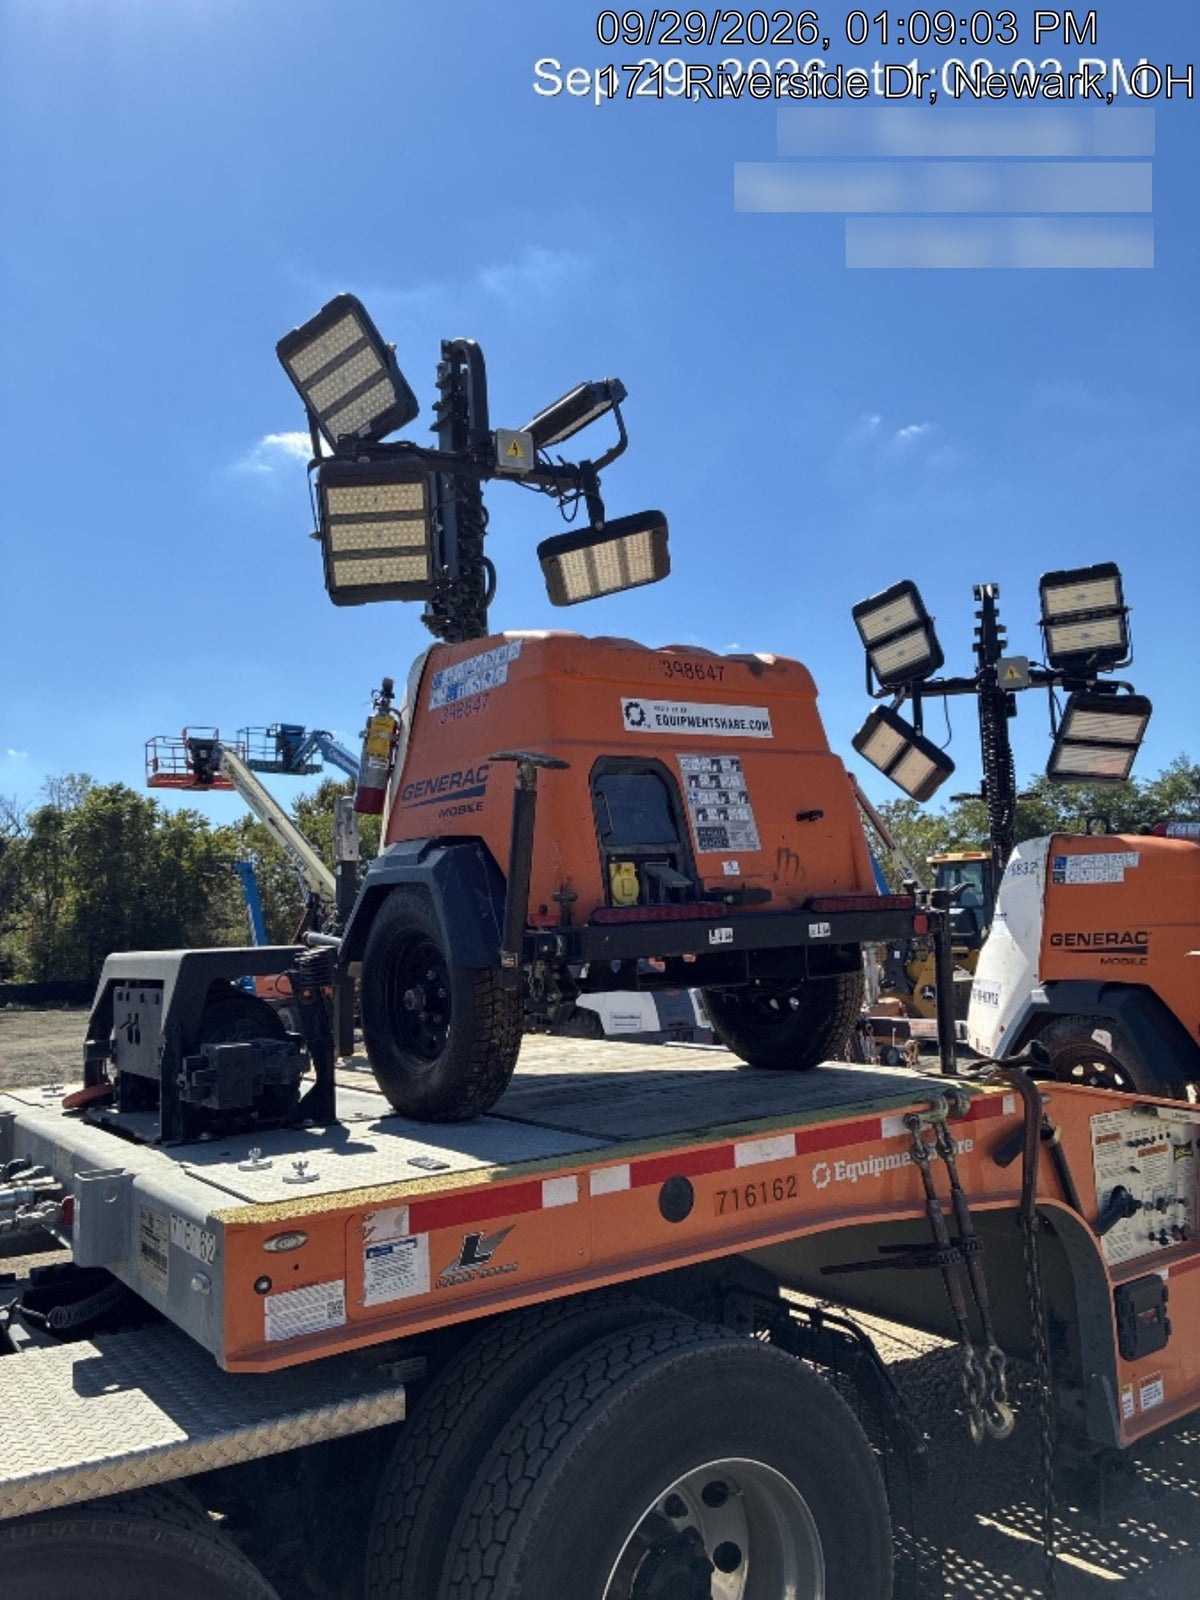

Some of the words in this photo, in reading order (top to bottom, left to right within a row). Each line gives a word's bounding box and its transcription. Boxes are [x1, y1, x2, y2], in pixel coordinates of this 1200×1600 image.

[661, 660, 725, 682] 398647
[402, 763, 490, 801] GENERAC
[438, 801, 485, 819] MOBILE
[1050, 932, 1149, 946] GENERAC
[1100, 957, 1148, 966] MOBILE
[715, 1175, 797, 1214] 716162
